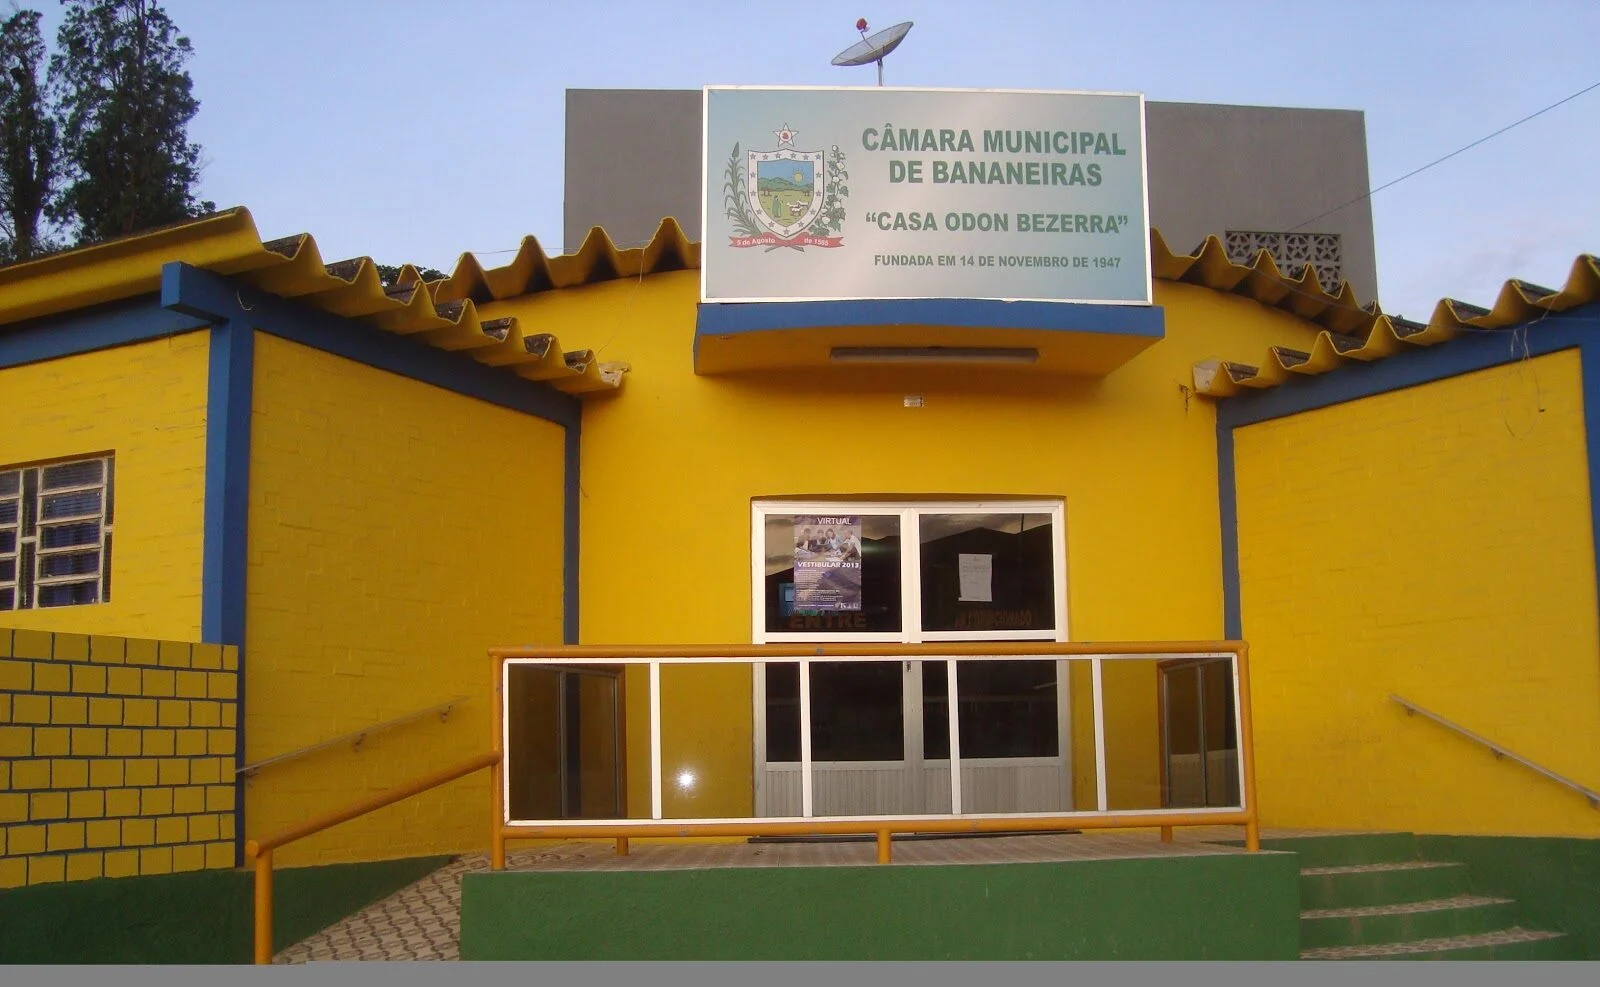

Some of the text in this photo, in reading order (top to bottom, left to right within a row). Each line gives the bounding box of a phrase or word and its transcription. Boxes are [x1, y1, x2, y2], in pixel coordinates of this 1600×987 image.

[862, 123, 1126, 156] CÂMARA MUNICIPAL
[889, 160, 1102, 186] DE BANANEIRAS
[945, 212, 1009, 232] ODON
[751, 237, 776, 246] Agosto
[874, 255, 1121, 268] FUNDADA EM 14 DE NOVEMBRO DE 1947
[817, 516, 852, 525] VIRTUAL
[788, 613, 868, 629] ENTRE
